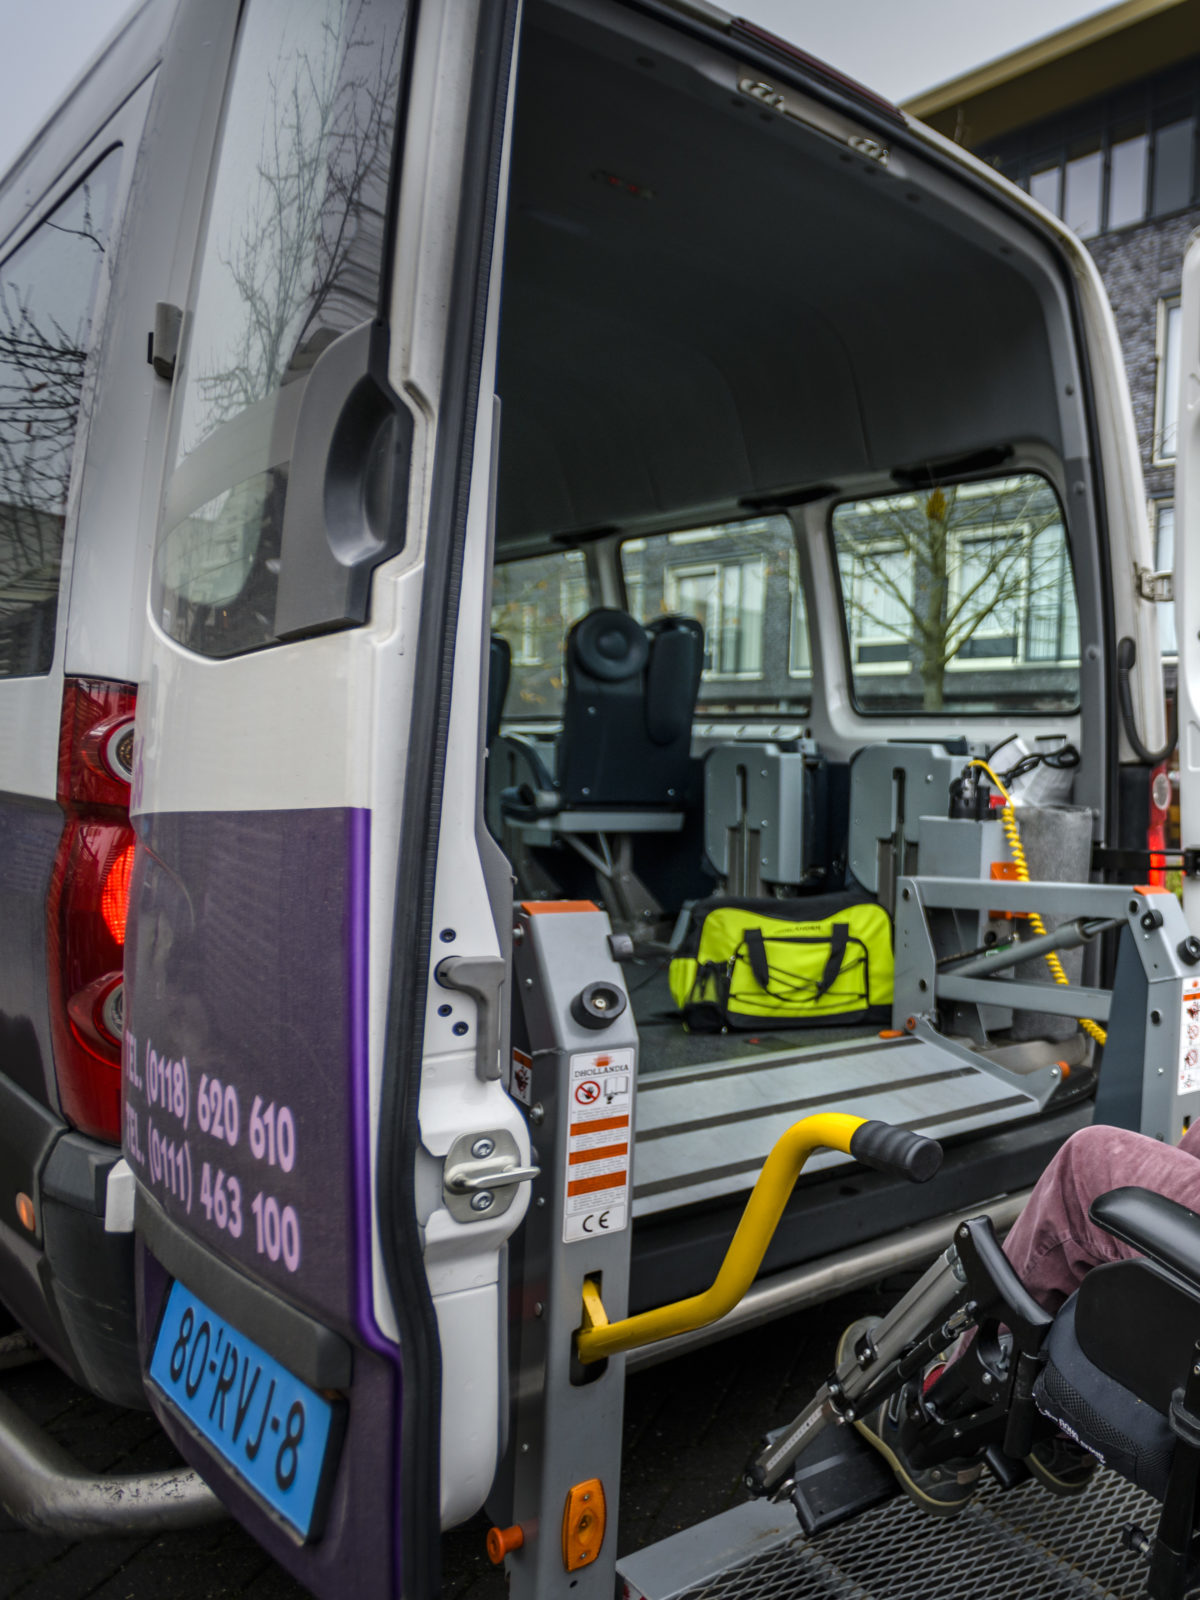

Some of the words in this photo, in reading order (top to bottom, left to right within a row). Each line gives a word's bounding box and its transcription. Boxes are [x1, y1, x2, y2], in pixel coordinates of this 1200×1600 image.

[146, 1038, 190, 1131] (0118)
[198, 1073, 239, 1146] 620
[250, 1095, 296, 1173] 610
[574, 1064, 629, 1078] DHOLLANDIA
[148, 1116, 193, 1215] (0111)
[200, 1162, 243, 1239] 463
[252, 1191, 300, 1273] 100
[582, 1210, 610, 1233] CE
